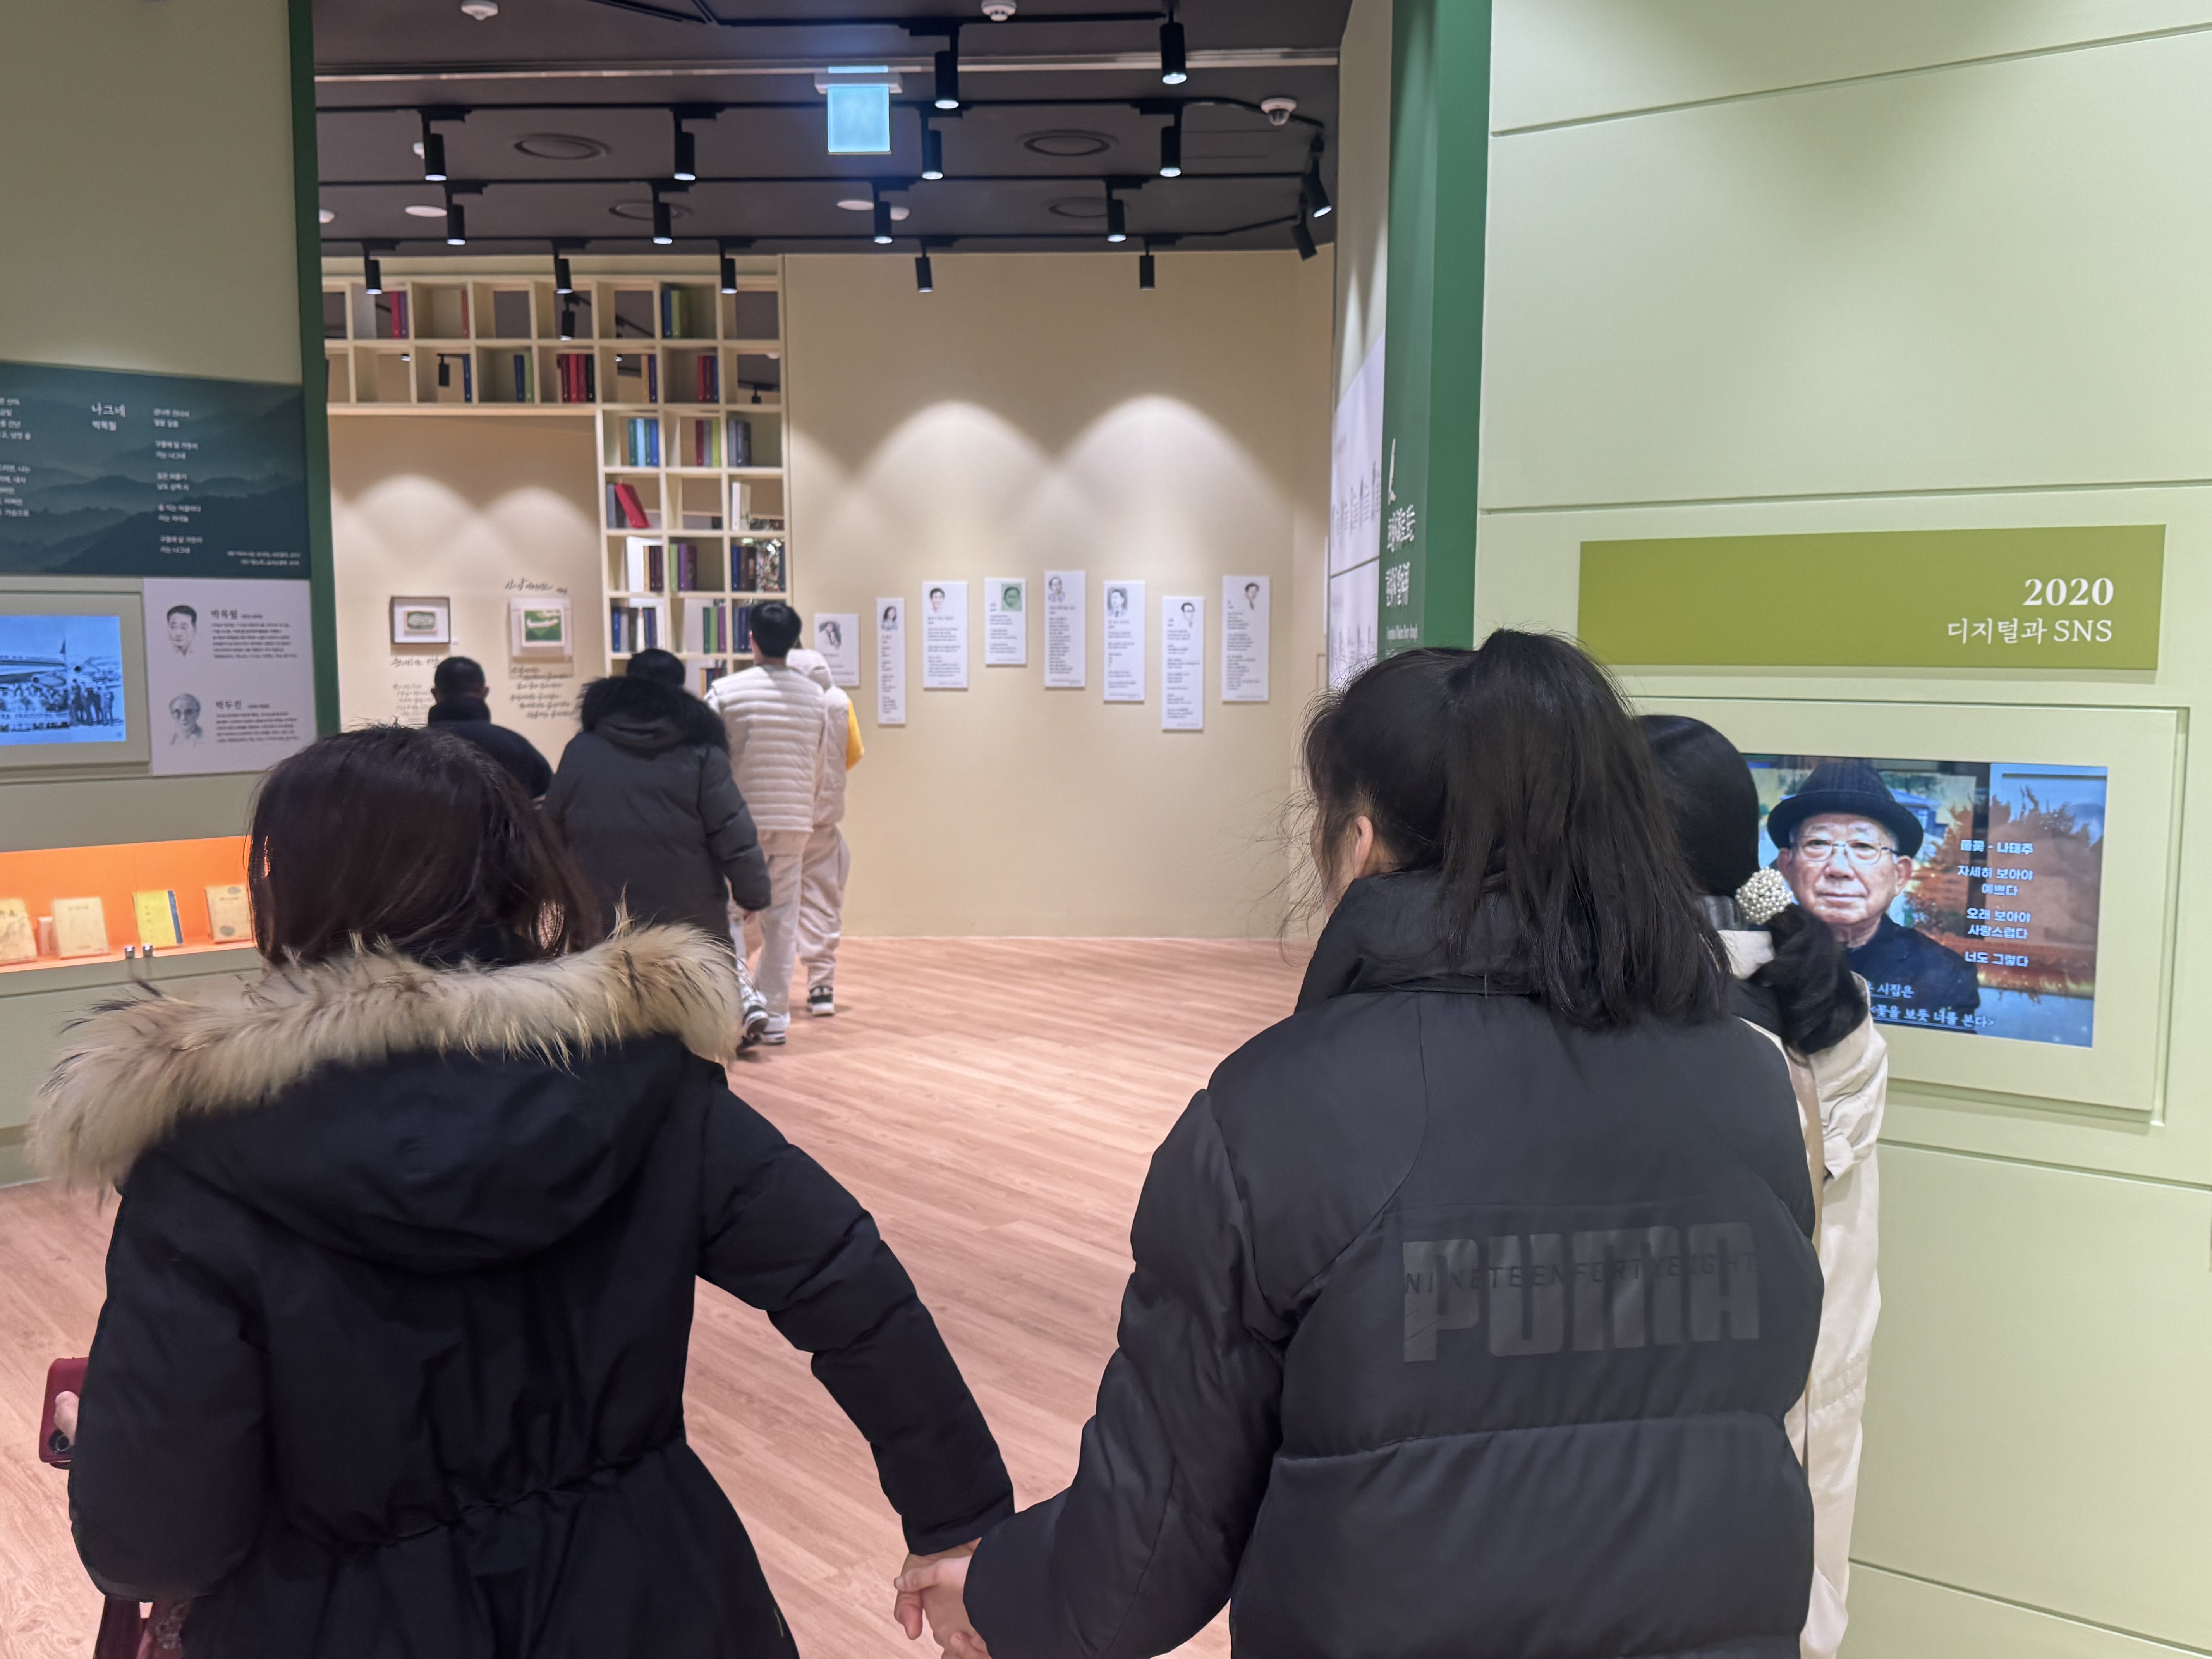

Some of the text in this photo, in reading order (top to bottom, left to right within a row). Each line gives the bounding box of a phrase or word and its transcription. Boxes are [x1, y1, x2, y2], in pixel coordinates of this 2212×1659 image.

[91, 402, 125, 417] 나그네
[92, 420, 117, 431] 박목월
[2022, 577, 2114, 606] 2020
[1947, 618, 2112, 644] 디지털과 SNS
[216, 700, 242, 711] 박두진
[1961, 839, 1985, 852] 풀꽃
[1997, 842, 2033, 855] 나태주
[1957, 865, 2033, 881] 자세히 보아야
[1981, 883, 2018, 896] 예쁘다
[1966, 907, 2031, 923] 오래 보아야
[1967, 924, 2028, 939] 사랑스럽다
[1965, 951, 2029, 967] 너도 그렇다
[1877, 982, 1915, 999] 시집은
[1904, 1008, 1930, 1023] 보듯
[1933, 1007, 1959, 1026] 너를
[1403, 1222, 1760, 1362] PUMA
